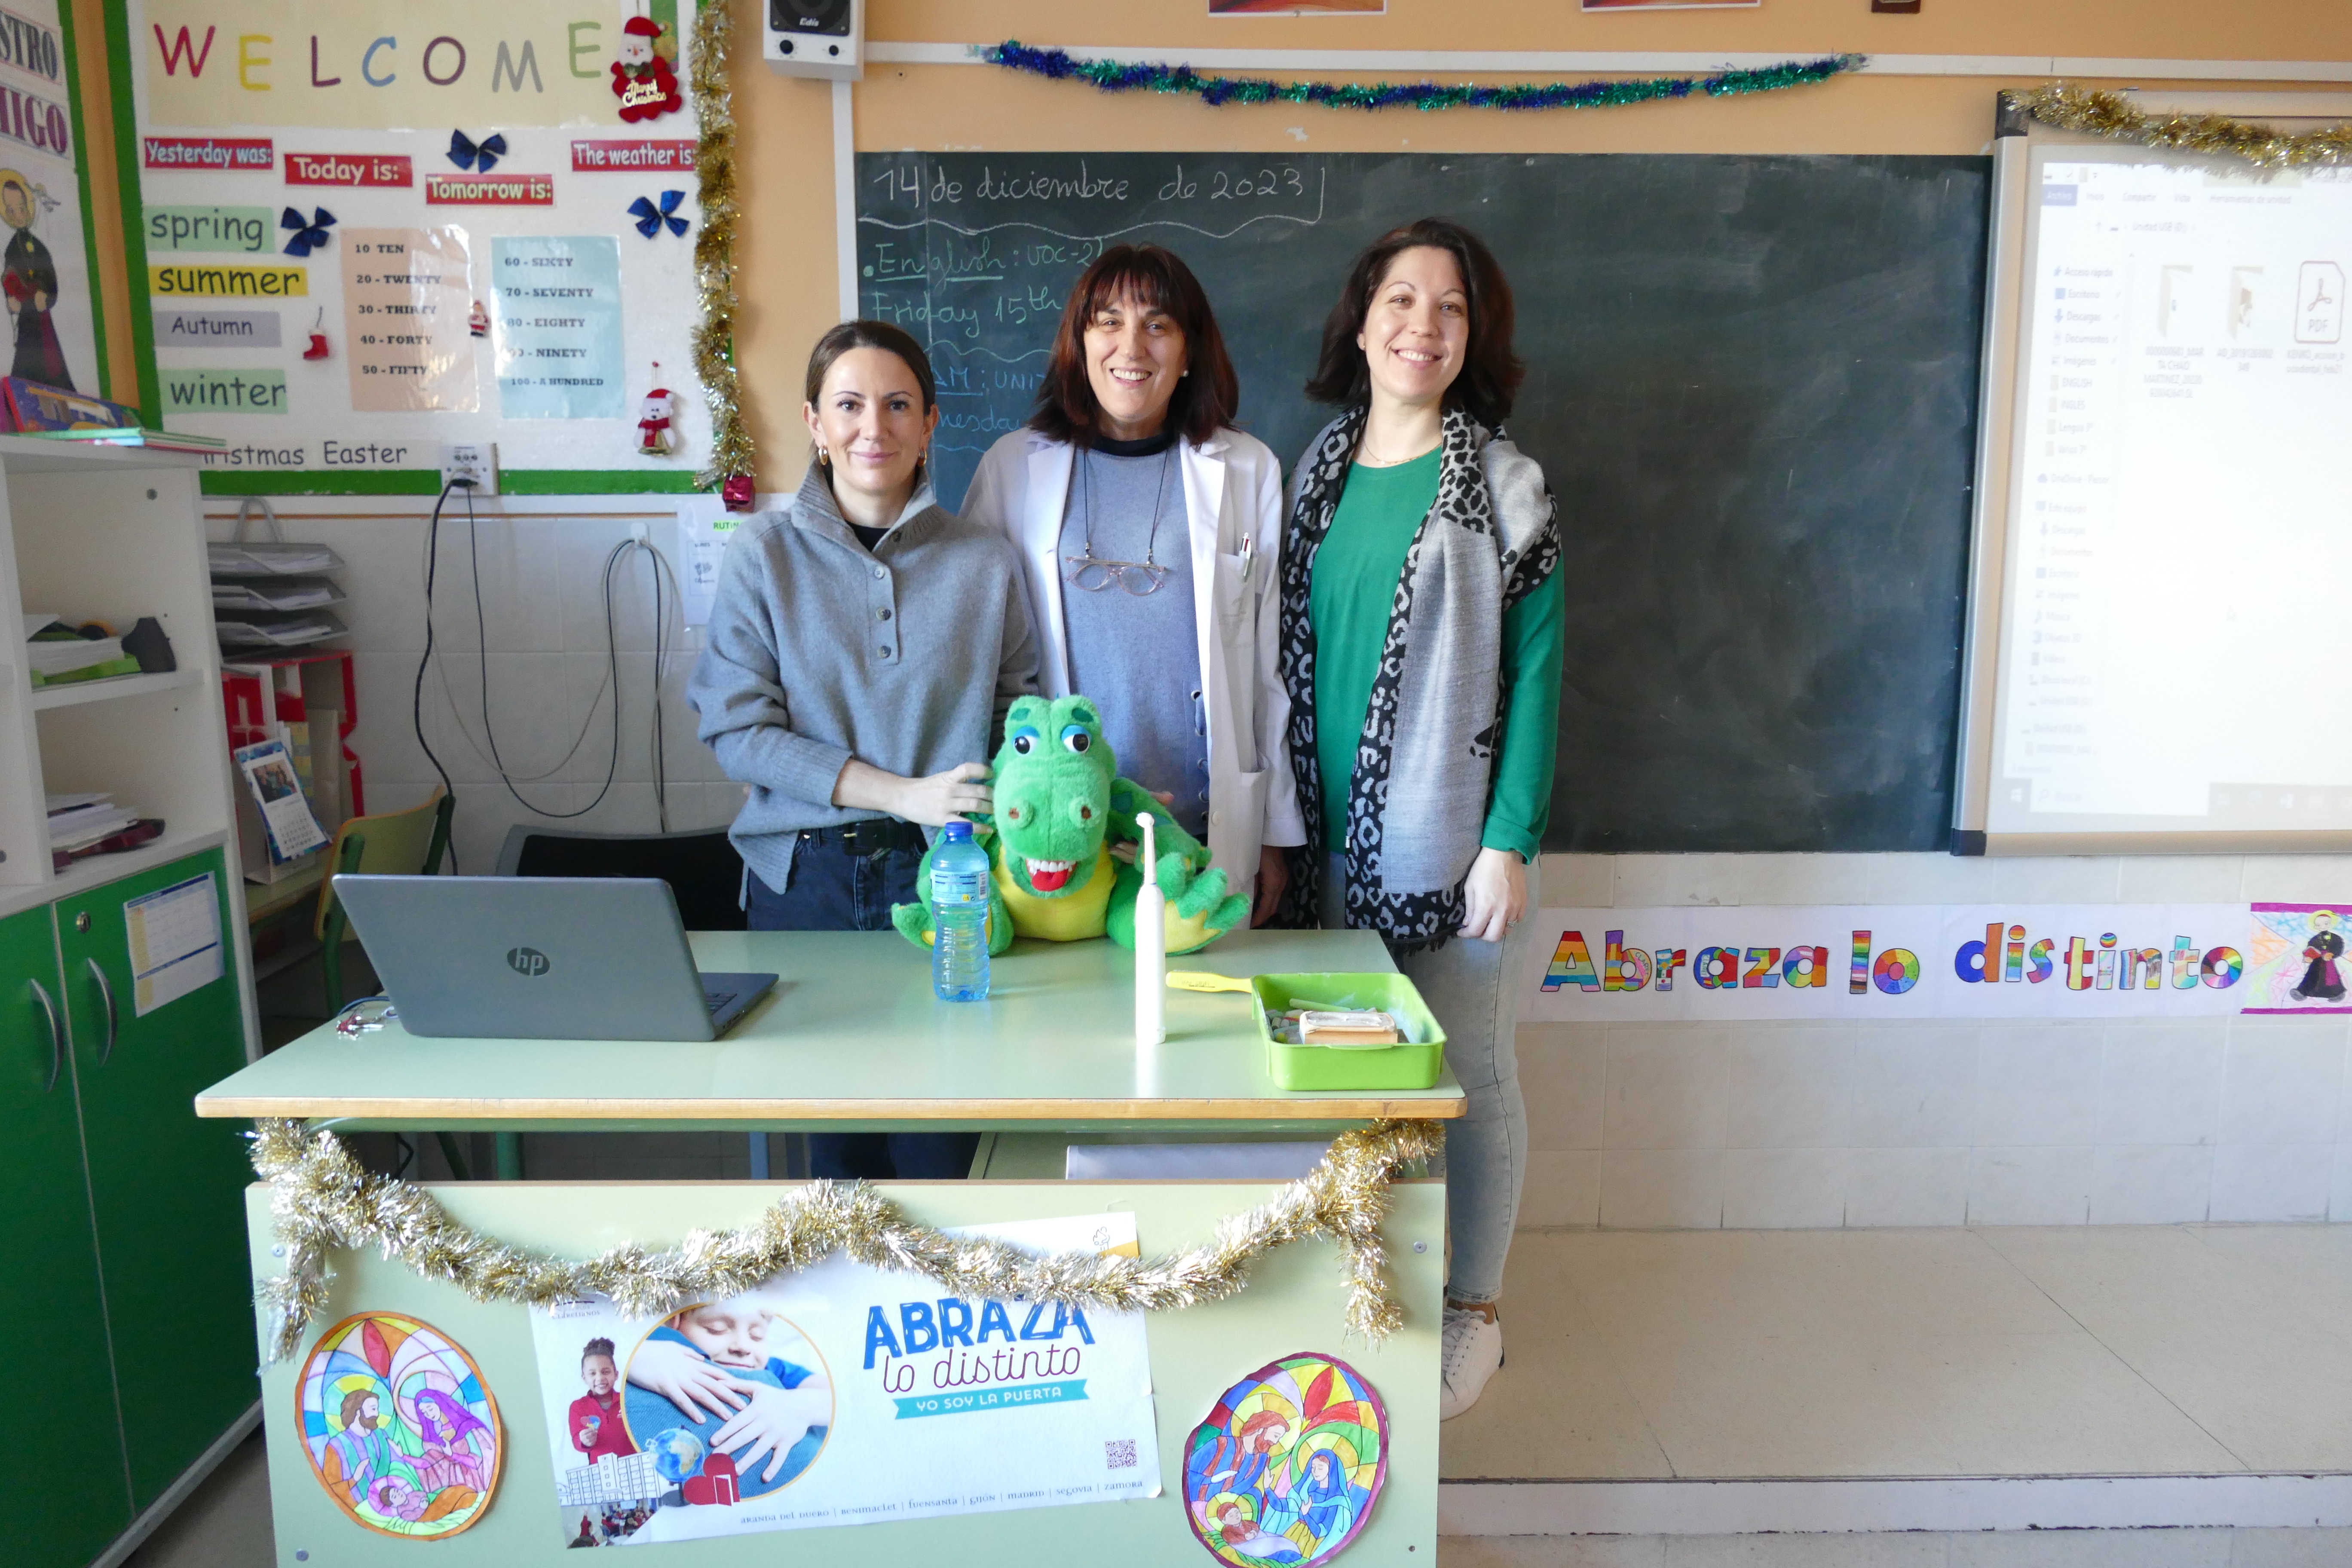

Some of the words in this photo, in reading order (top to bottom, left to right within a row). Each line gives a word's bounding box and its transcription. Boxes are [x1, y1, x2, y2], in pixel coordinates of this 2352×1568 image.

[153, 21, 602, 93] WELCOME
[147, 141, 233, 167] Yesterday
[236, 147, 272, 164] was:
[574, 143, 604, 164] The
[609, 144, 674, 165] weather
[679, 145, 695, 164] is:
[294, 157, 364, 185] Today
[372, 158, 399, 181] is:
[430, 177, 524, 199] Tomorrow
[530, 177, 551, 199] is:
[873, 165, 920, 208] 14
[931, 165, 963, 203] de
[977, 159, 1129, 200] diciembre
[1158, 165, 1197, 201] de
[1211, 168, 1303, 199] 2023
[2123, 192, 2156, 202] Compartir
[2174, 194, 2191, 202] Vista
[2210, 195, 2254, 203] Herramientas
[2267, 196, 2291, 204] unidad
[151, 209, 263, 251] spring
[2133, 222, 2157, 232] Unidad
[2159, 222, 2172, 232] USB
[355, 244, 370, 253] 10
[377, 244, 404, 254] TEN
[505, 257, 520, 266] 60
[532, 257, 573, 267] SIXTY
[2064, 266, 2090, 276] Acceso
[158, 268, 300, 295] summer
[356, 274, 372, 284] 20
[383, 274, 442, 284] TWENTY
[505, 287, 521, 297] 70
[533, 288, 594, 297] SEVENTY
[2068, 288, 2101, 298] Escritorio
[358, 304, 374, 314] 30
[385, 305, 436, 314] THIRTY
[872, 290, 980, 338] Friday
[995, 285, 1062, 324] 15th
[507, 318, 522, 327] 80
[534, 318, 586, 327] EIGHTY
[2067, 311, 2101, 324] Descargas
[172, 316, 253, 336] Autumn
[2307, 318, 2329, 333] PDF
[360, 335, 376, 344] 40
[387, 335, 432, 345] FORTY
[2065, 333, 2109, 344] Documentos
[536, 348, 587, 358] NINETY
[361, 365, 378, 374] 50
[389, 365, 428, 375] FIFTY
[539, 377, 546, 386] A
[549, 377, 604, 386] HUNDRED
[2062, 377, 2093, 388] ENGLISH
[171, 375, 287, 406] winter
[324, 441, 407, 464] Easter
[512, 947, 545, 976] hp
[1540, 930, 1828, 992] Abraza
[1849, 930, 1920, 995] lo
[1954, 922, 2243, 991] distinto
[863, 1294, 1096, 1370] ABRAZA
[882, 1355, 915, 1393] lo
[933, 1344, 1081, 1388] distinto
[916, 1400, 938, 1412] YO
[944, 1396, 974, 1409] SOY
[979, 1393, 998, 1406] LA
[1004, 1386, 1062, 1403] PUERTA
